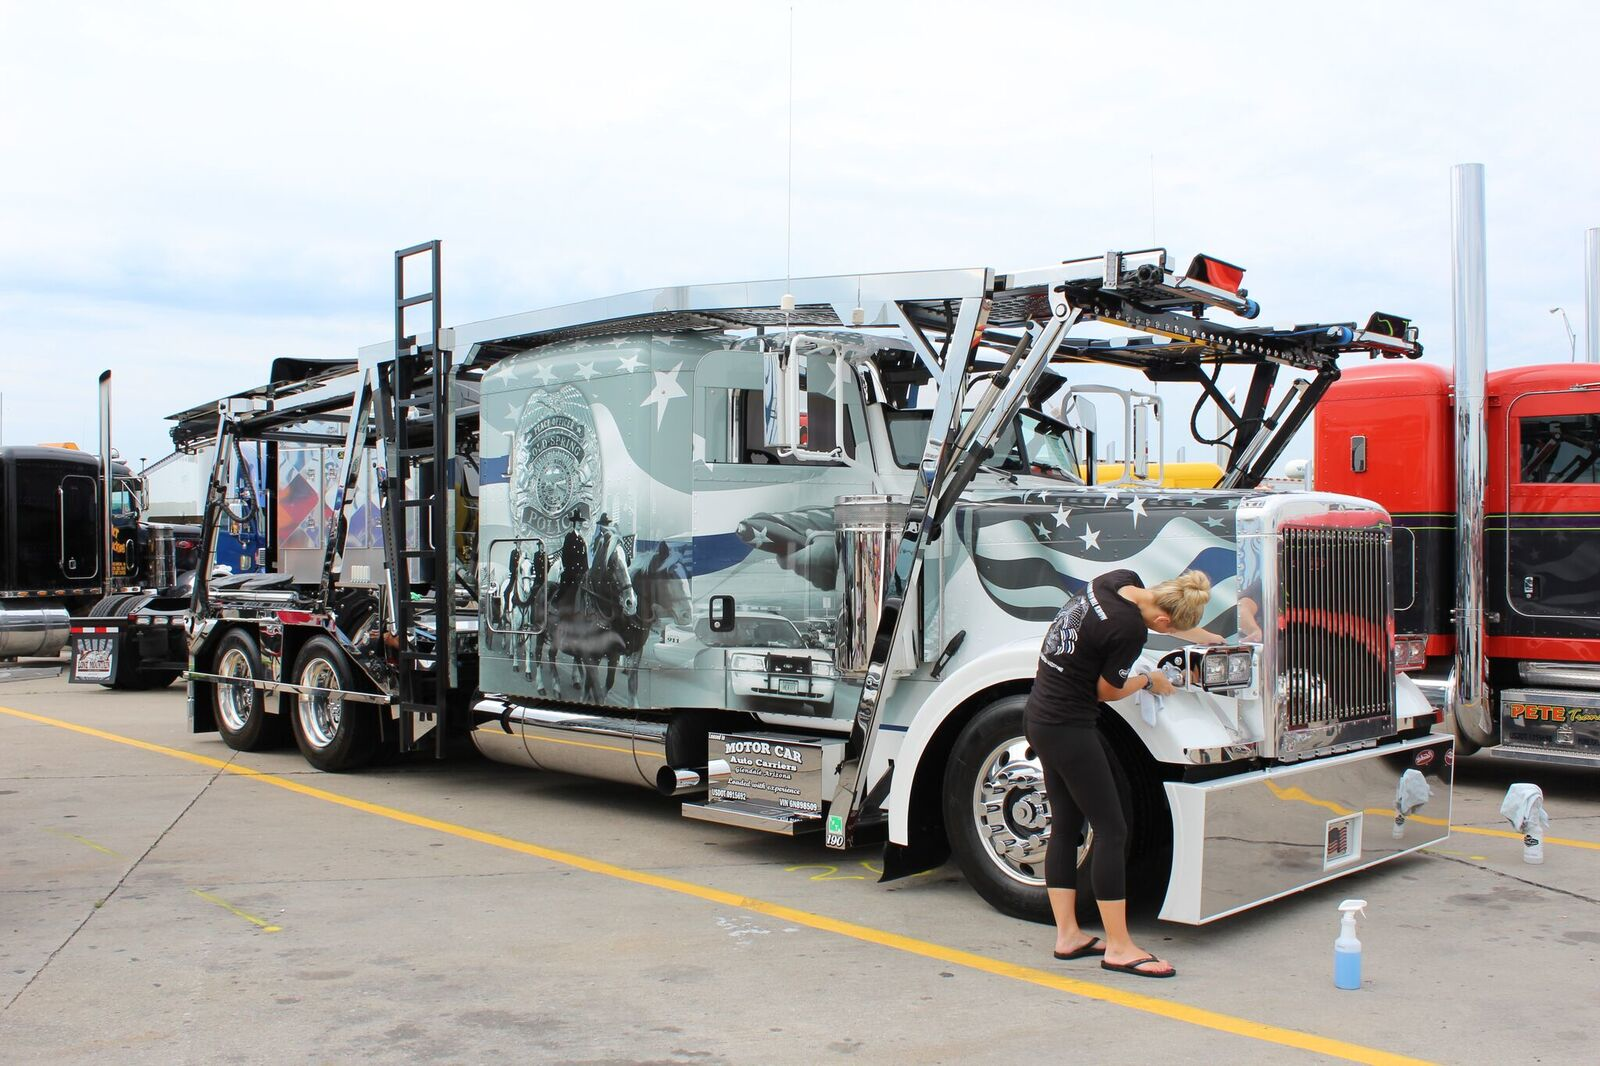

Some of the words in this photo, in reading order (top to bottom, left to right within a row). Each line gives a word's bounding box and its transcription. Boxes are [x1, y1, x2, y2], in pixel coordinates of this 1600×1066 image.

[533, 418, 550, 434] PEACE
[551, 417, 574, 431] OFFICER
[550, 435, 581, 457] SPRING
[1510, 703, 1566, 722] PETE
[725, 741, 771, 755] MOTOR
[775, 745, 803, 764] CAR
[730, 755, 753, 766] Auto
[755, 758, 797, 772] Carriers
[735, 766, 763, 776] Glendale
[763, 771, 792, 780] Arizona
[727, 778, 751, 787] Loaded
[752, 781, 766, 790] with
[767, 784, 801, 795] experience
[779, 798, 789, 807] VIN
[826, 834, 844, 847] 190
